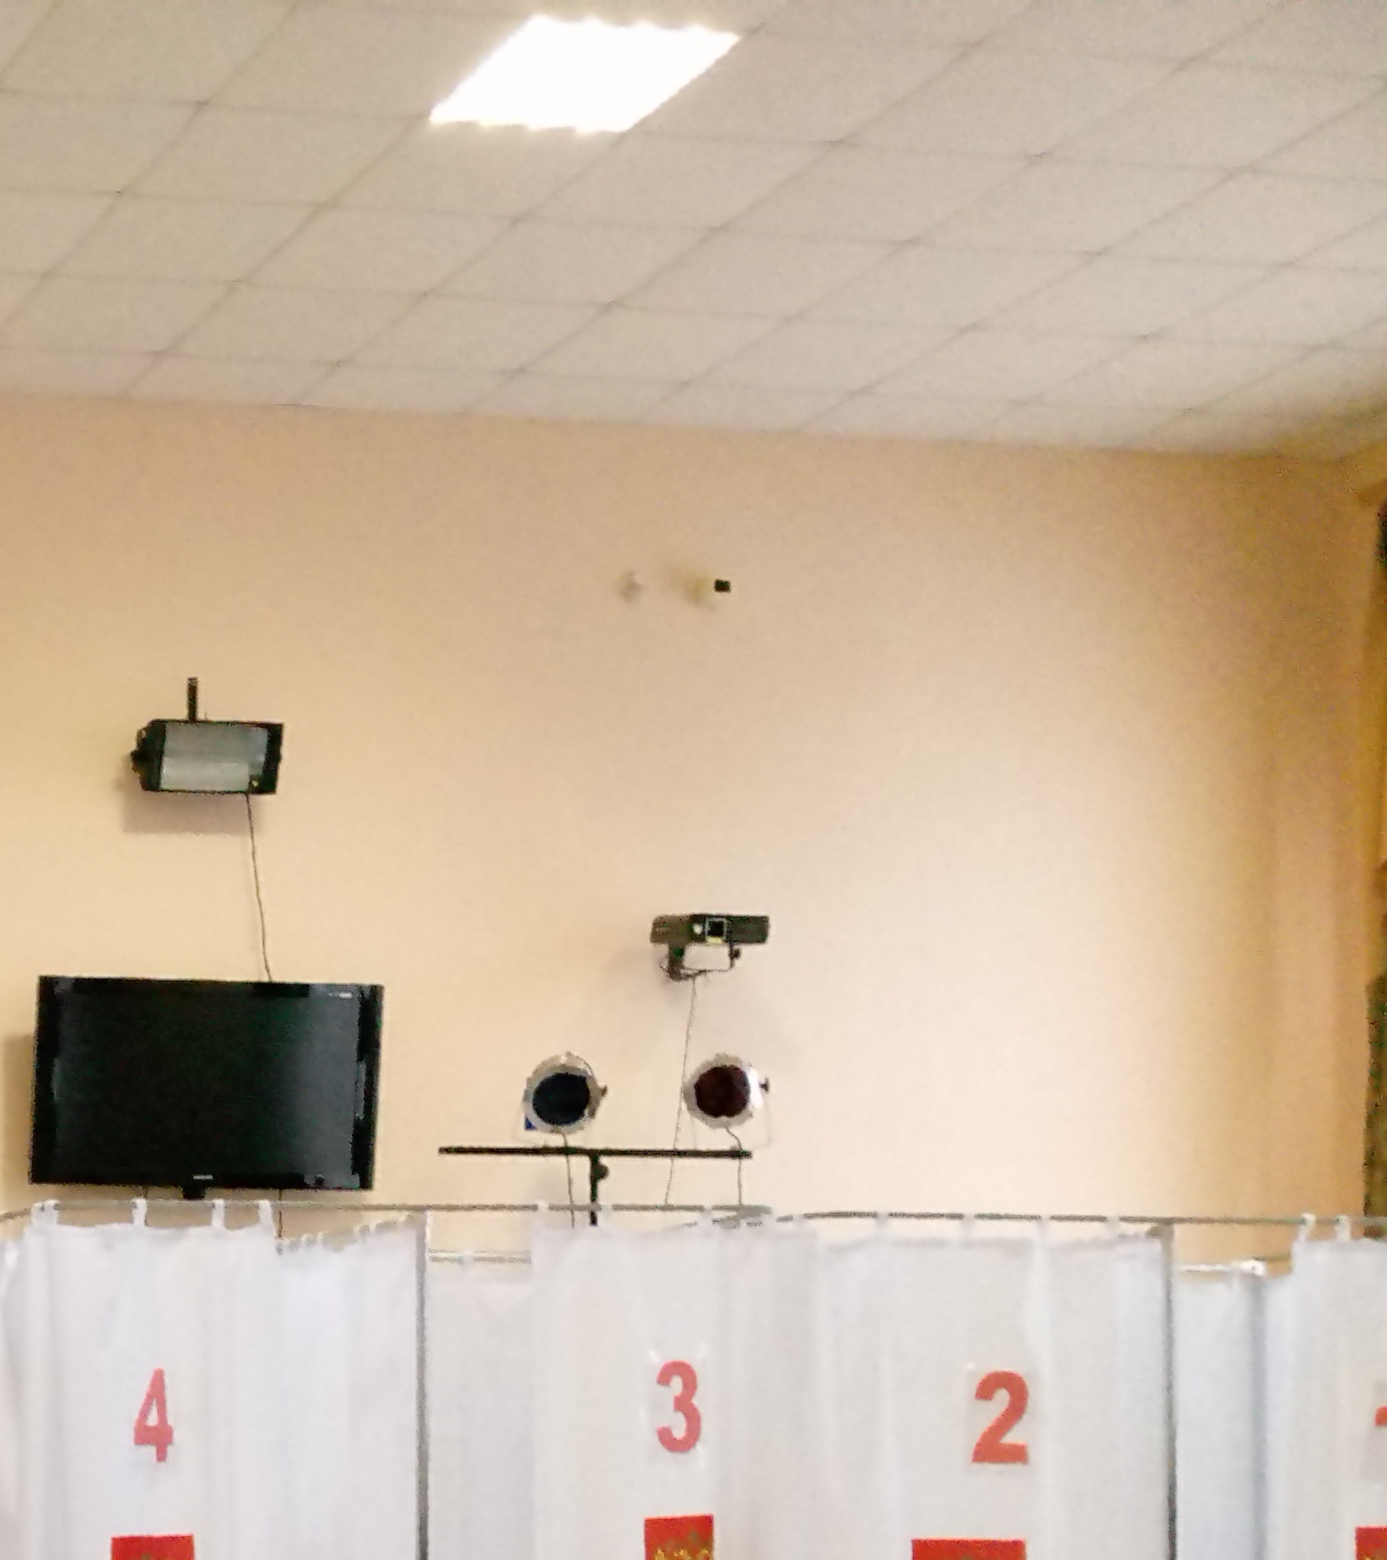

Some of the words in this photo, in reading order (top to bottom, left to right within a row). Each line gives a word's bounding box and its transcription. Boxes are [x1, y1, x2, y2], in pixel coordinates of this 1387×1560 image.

[134, 1368, 174, 1462] 4
[656, 1360, 702, 1453] 3
[972, 1371, 1029, 1464] 2
